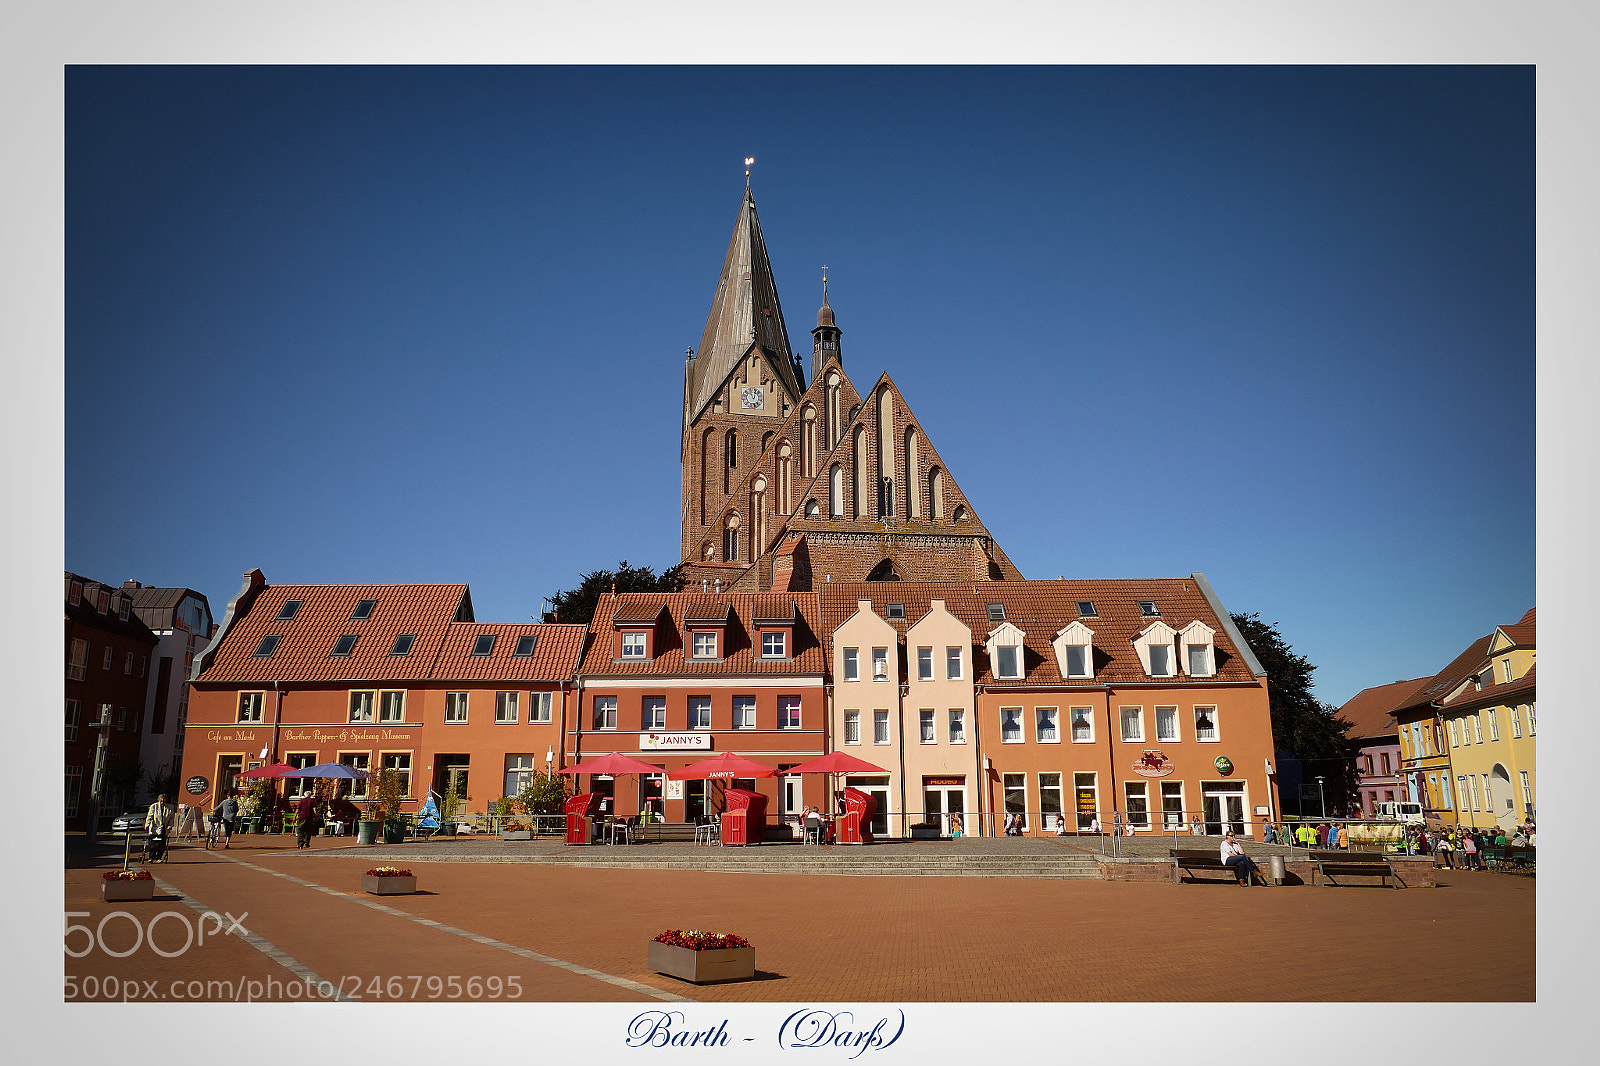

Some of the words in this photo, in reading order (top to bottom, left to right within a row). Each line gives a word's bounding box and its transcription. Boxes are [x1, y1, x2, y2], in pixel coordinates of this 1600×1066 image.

[234, 730, 256, 741] Markt
[284, 728, 312, 741] Barther
[339, 728, 349, 743] &
[349, 729, 379, 743] Spielzeug
[381, 729, 411, 740] Museum
[660, 736, 702, 745] JANNY'S
